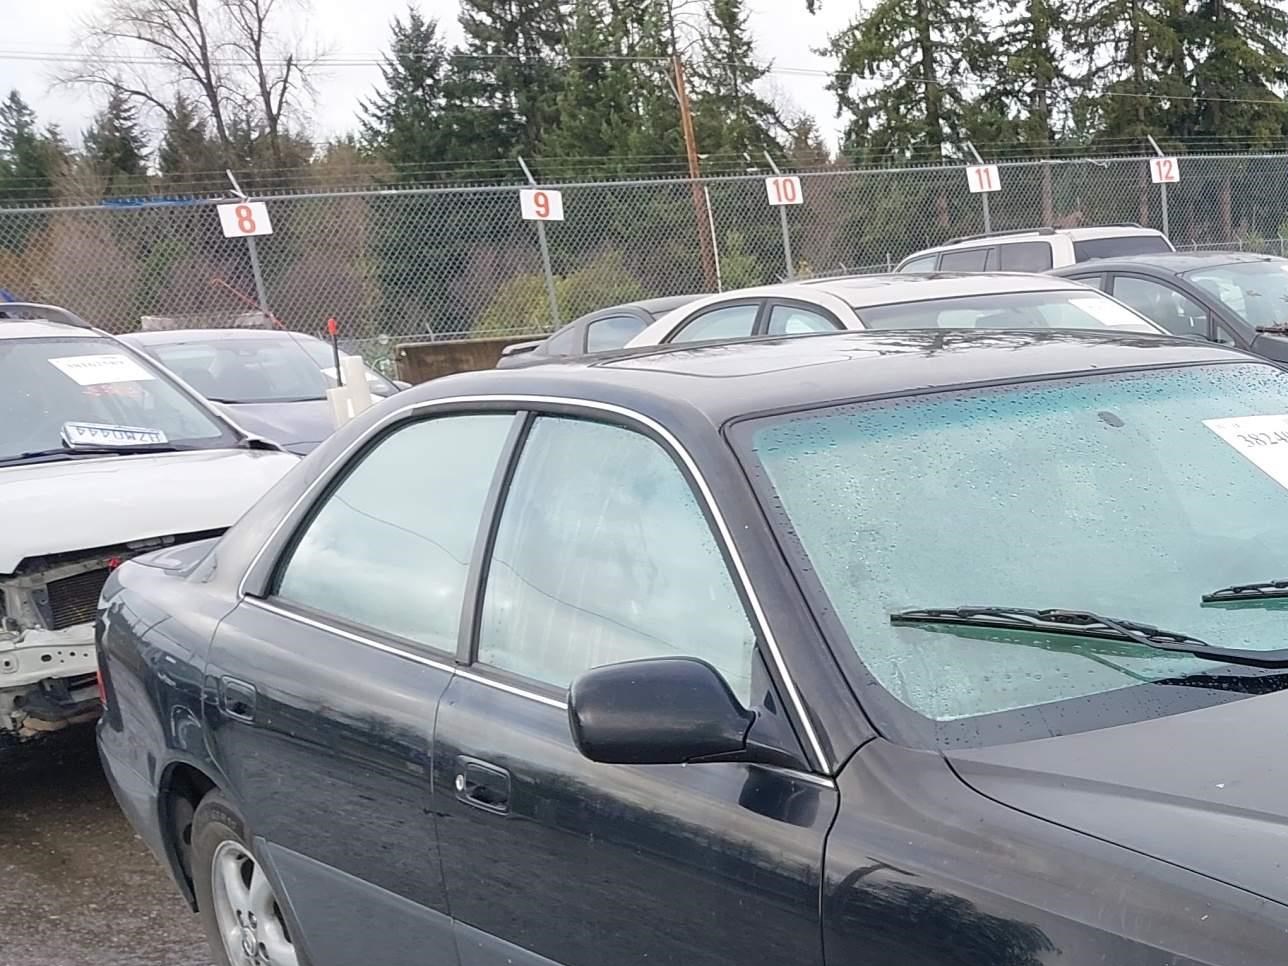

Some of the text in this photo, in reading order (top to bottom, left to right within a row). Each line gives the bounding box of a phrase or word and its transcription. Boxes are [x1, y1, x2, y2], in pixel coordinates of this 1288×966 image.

[975, 167, 992, 190] 11
[1155, 160, 1175, 181] 12
[772, 178, 796, 203] 10
[534, 191, 550, 218] 9
[235, 205, 256, 234] 8
